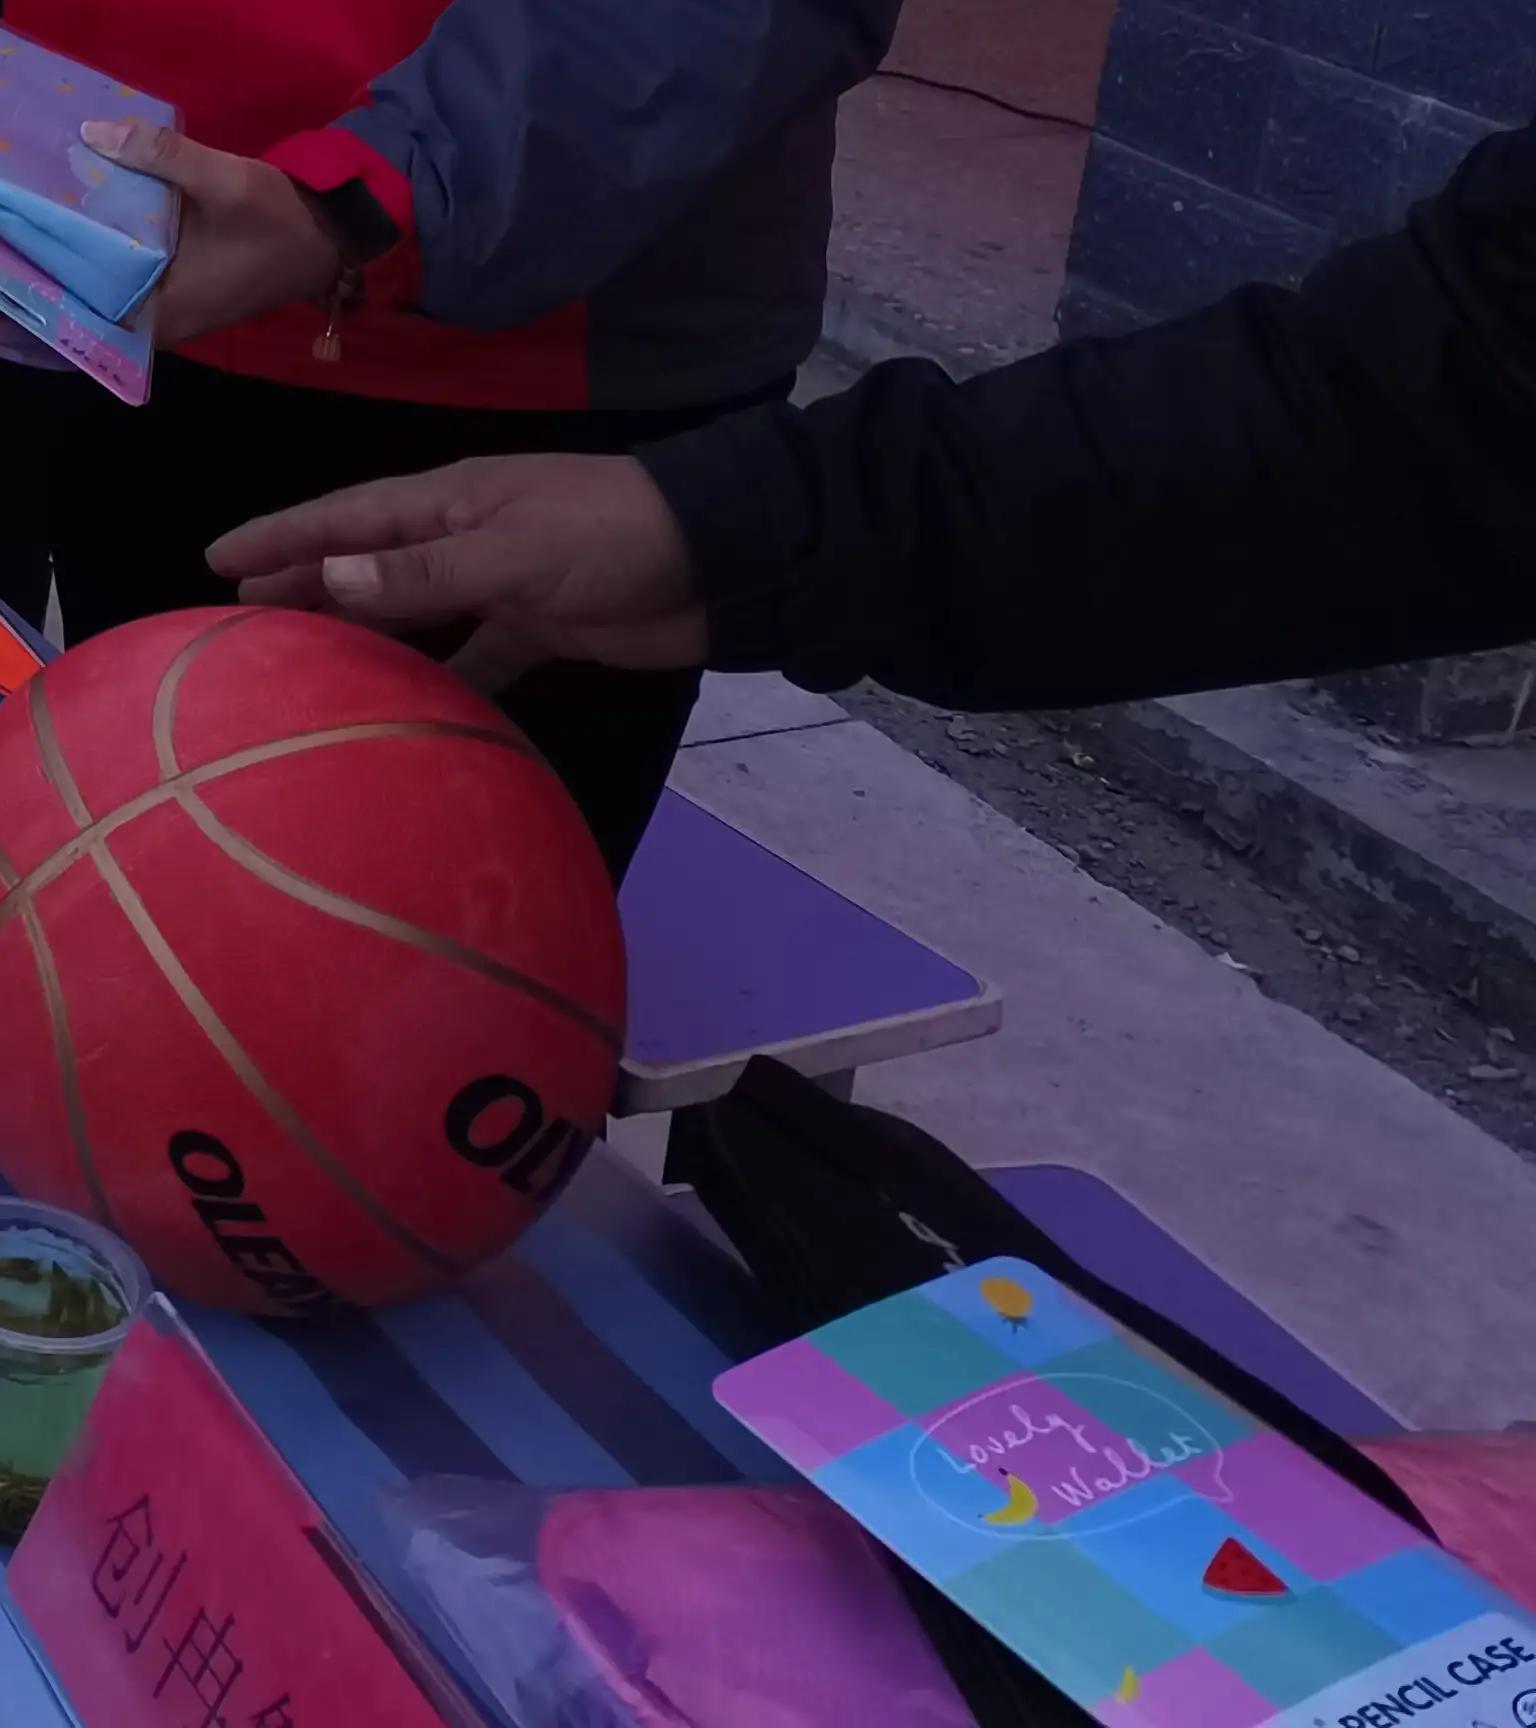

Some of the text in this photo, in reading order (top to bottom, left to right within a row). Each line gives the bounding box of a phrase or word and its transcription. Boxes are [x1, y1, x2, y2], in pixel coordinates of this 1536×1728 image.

[936, 1403, 1097, 1474] Lovely
[1051, 1431, 1202, 1508] Wallet
[1447, 1636, 1536, 1686] CASE
